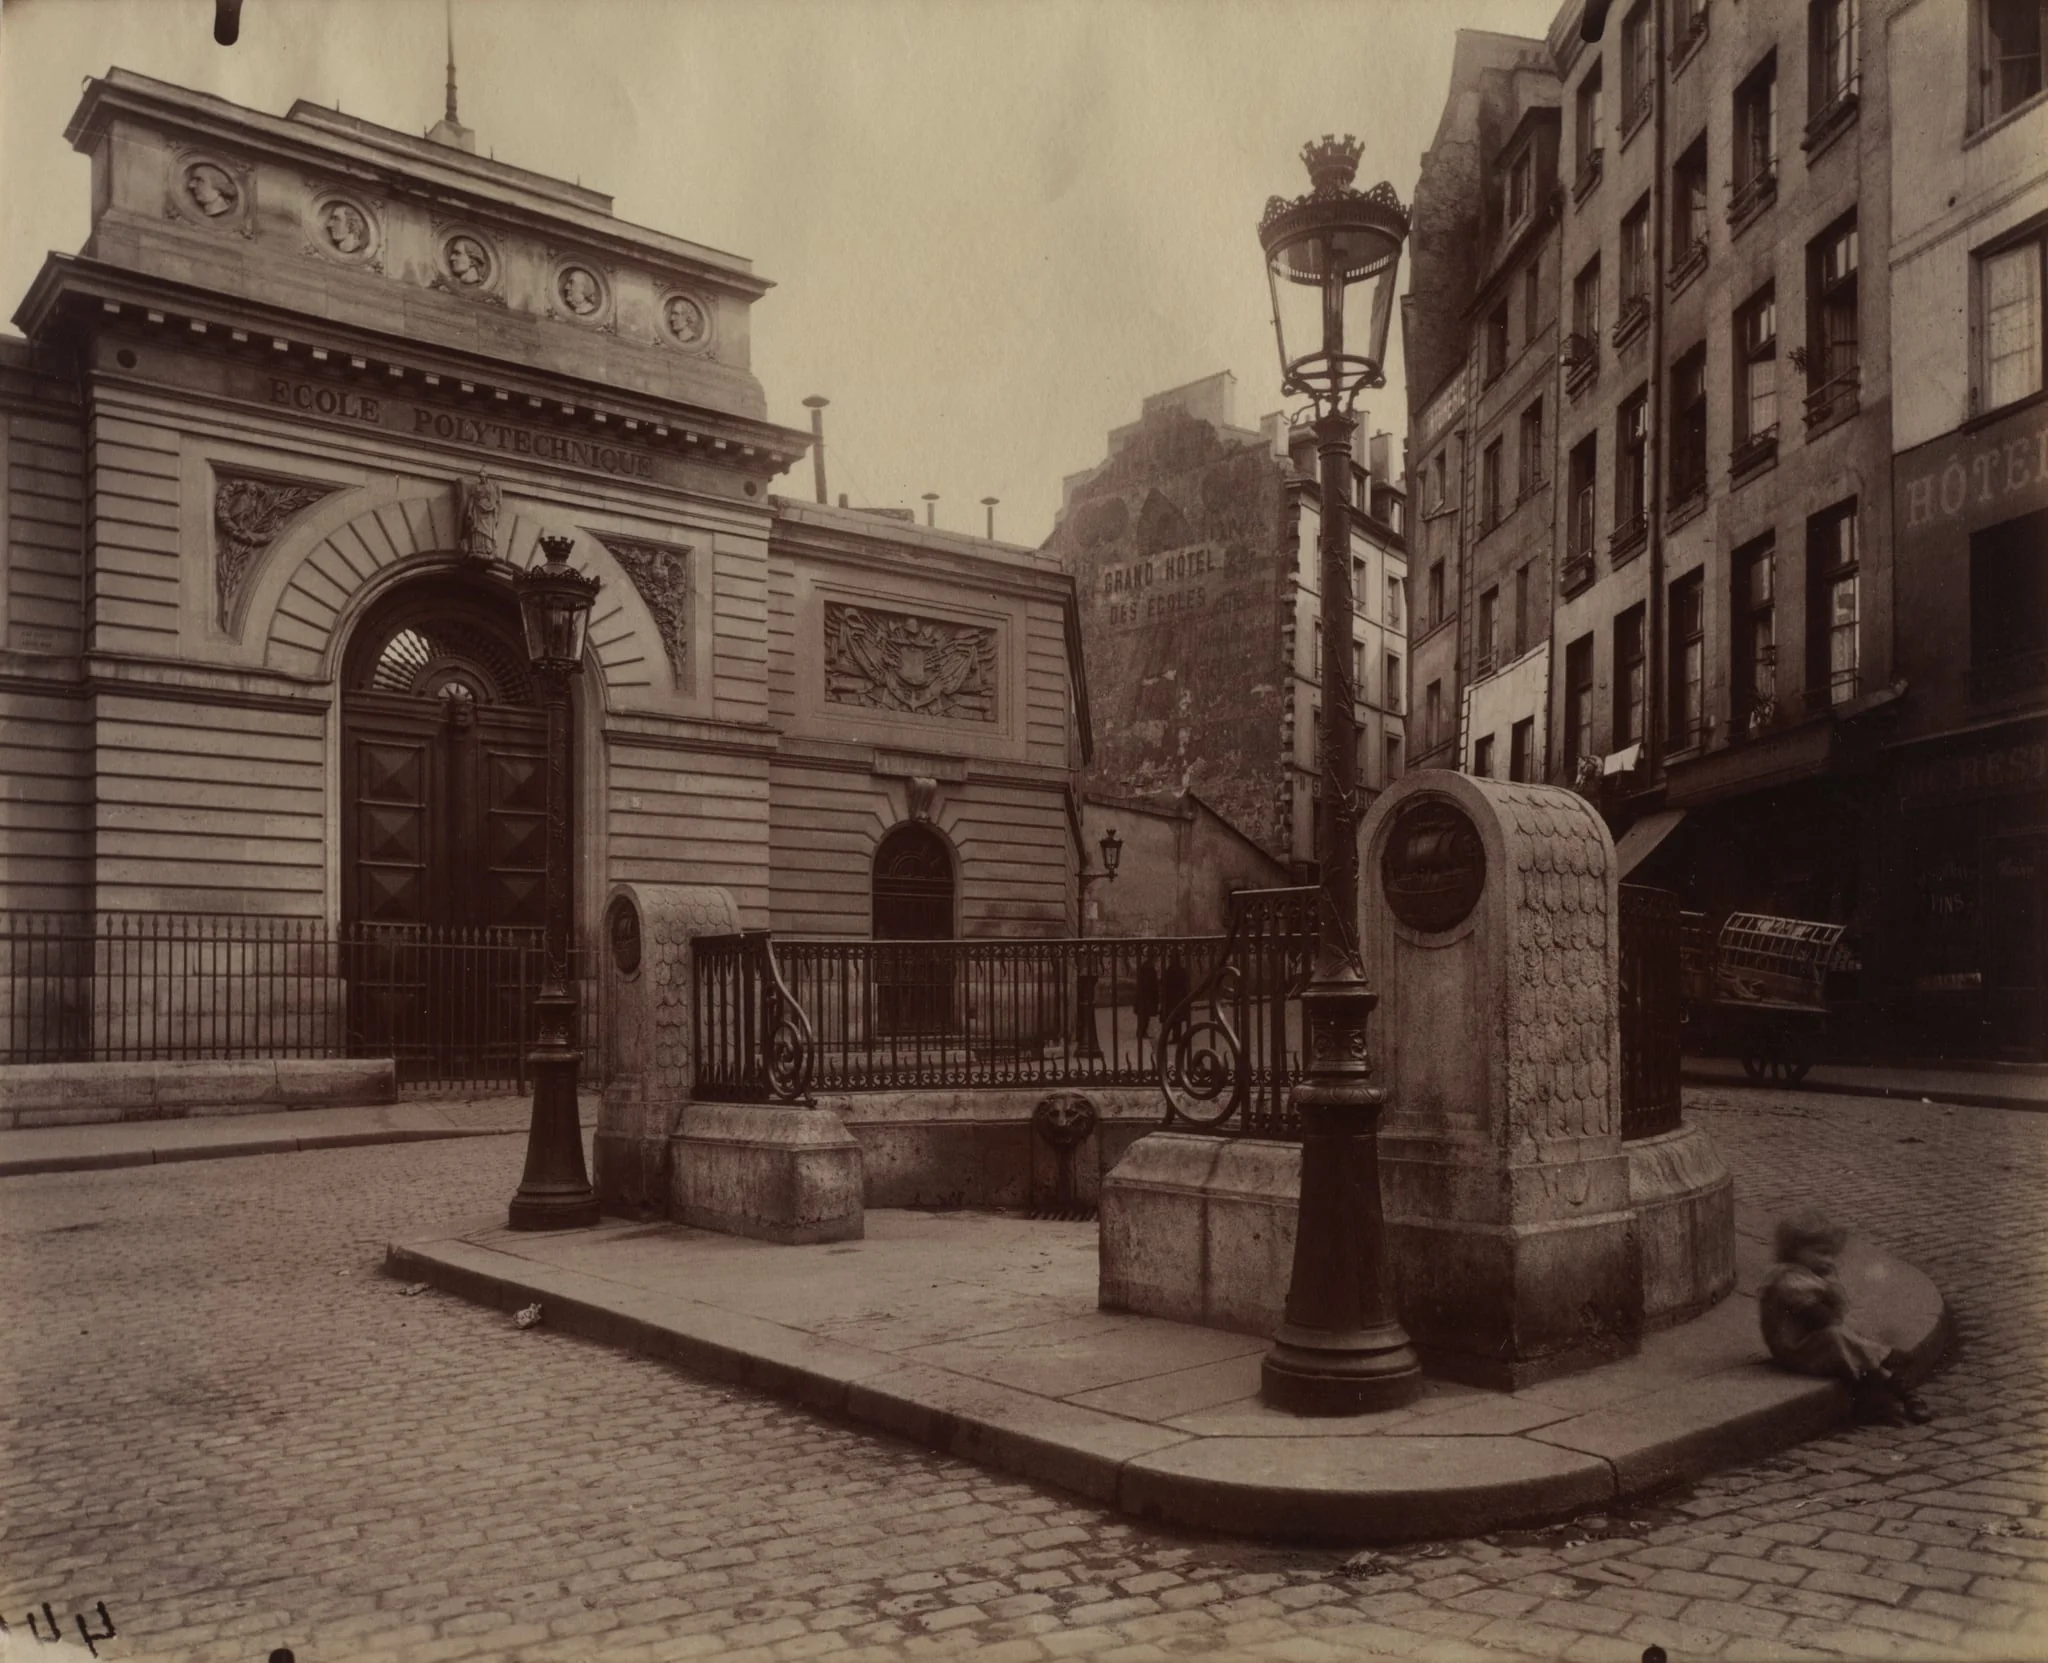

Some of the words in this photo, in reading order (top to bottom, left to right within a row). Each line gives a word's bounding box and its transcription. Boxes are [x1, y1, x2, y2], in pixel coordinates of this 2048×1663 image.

[268, 378, 380, 424] ECOLE
[413, 407, 654, 478] POLYTECHNIQUE
[1104, 562, 1154, 594] GRAND
[1110, 601, 1138, 626] DES
